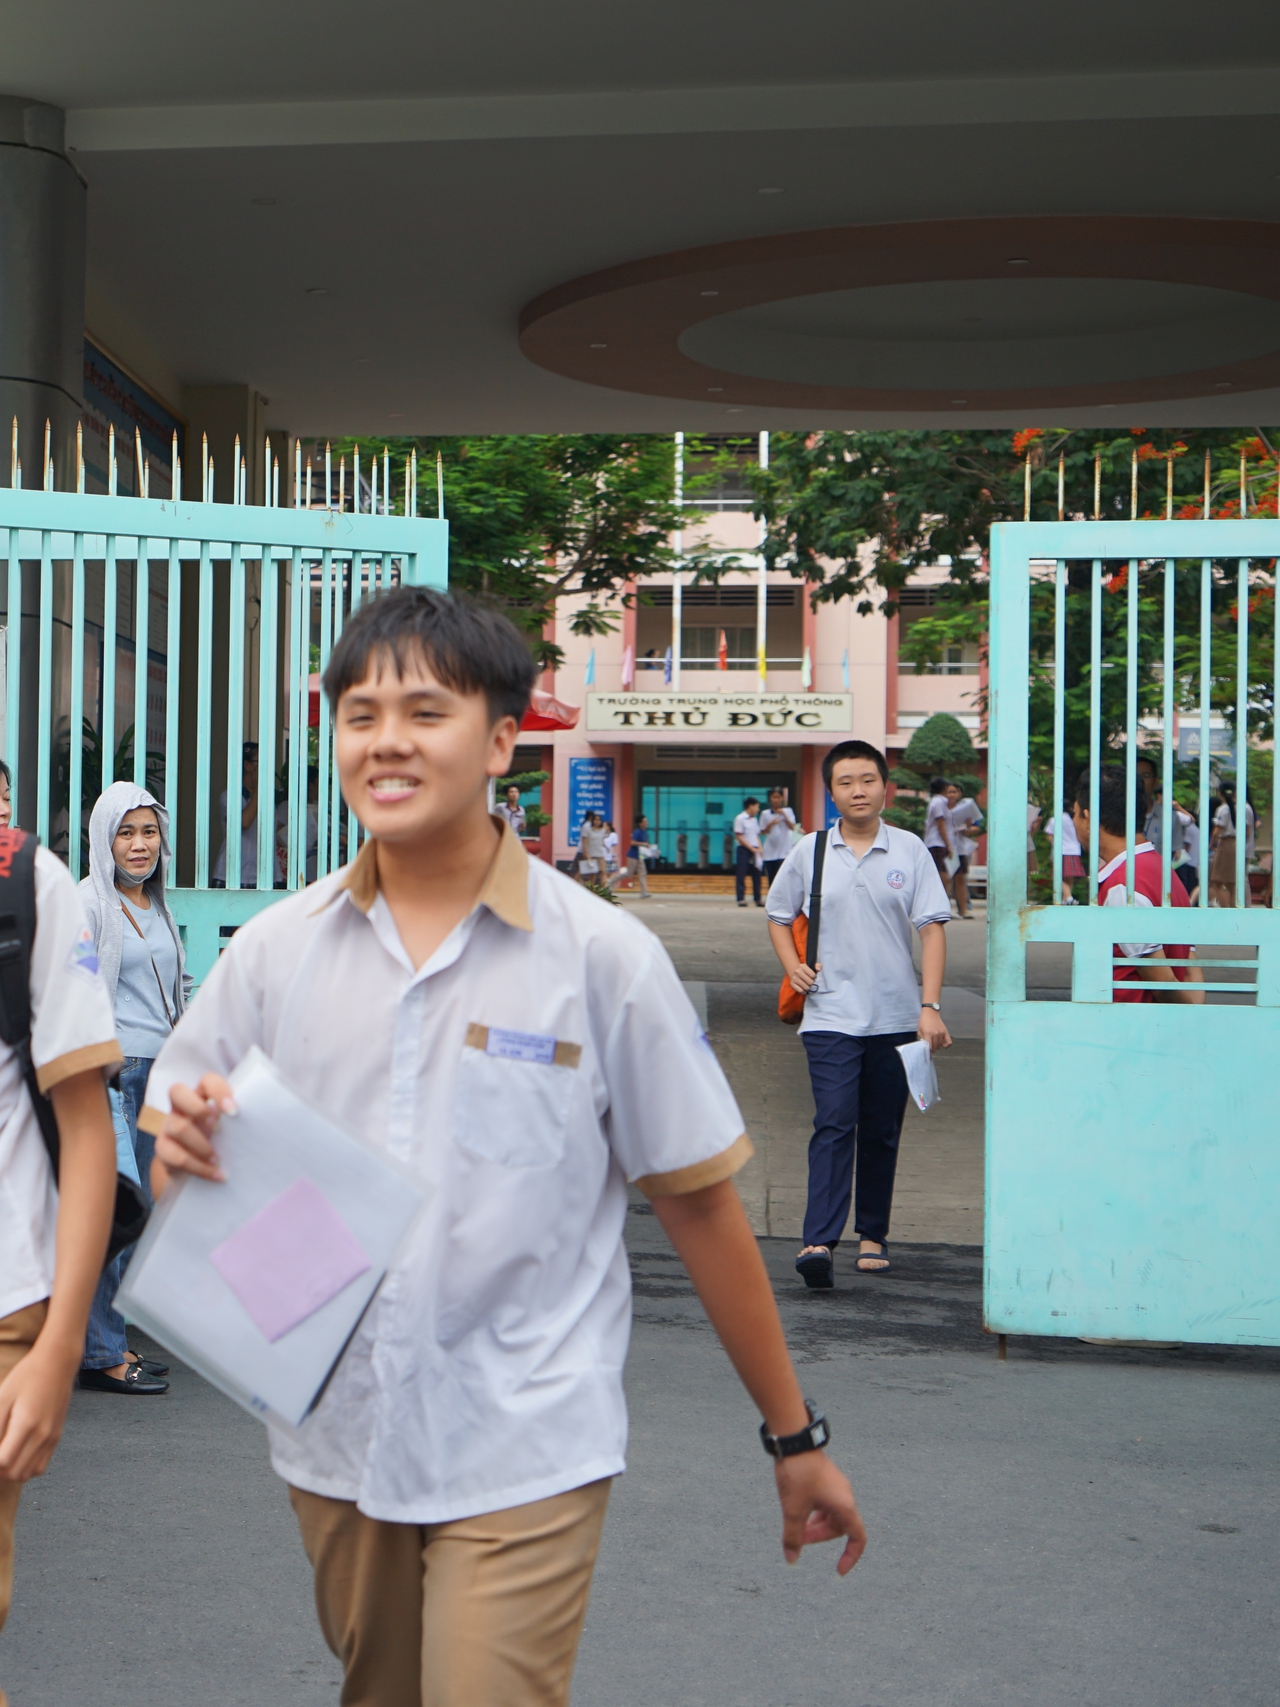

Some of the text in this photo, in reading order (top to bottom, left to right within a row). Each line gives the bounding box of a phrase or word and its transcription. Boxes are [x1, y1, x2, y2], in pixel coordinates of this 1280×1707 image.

[597, 695, 843, 707] TRƯỜNG TRUNG HỌC PHỔ THÔNG
[613, 707, 822, 727] THỦ ĐỨC
